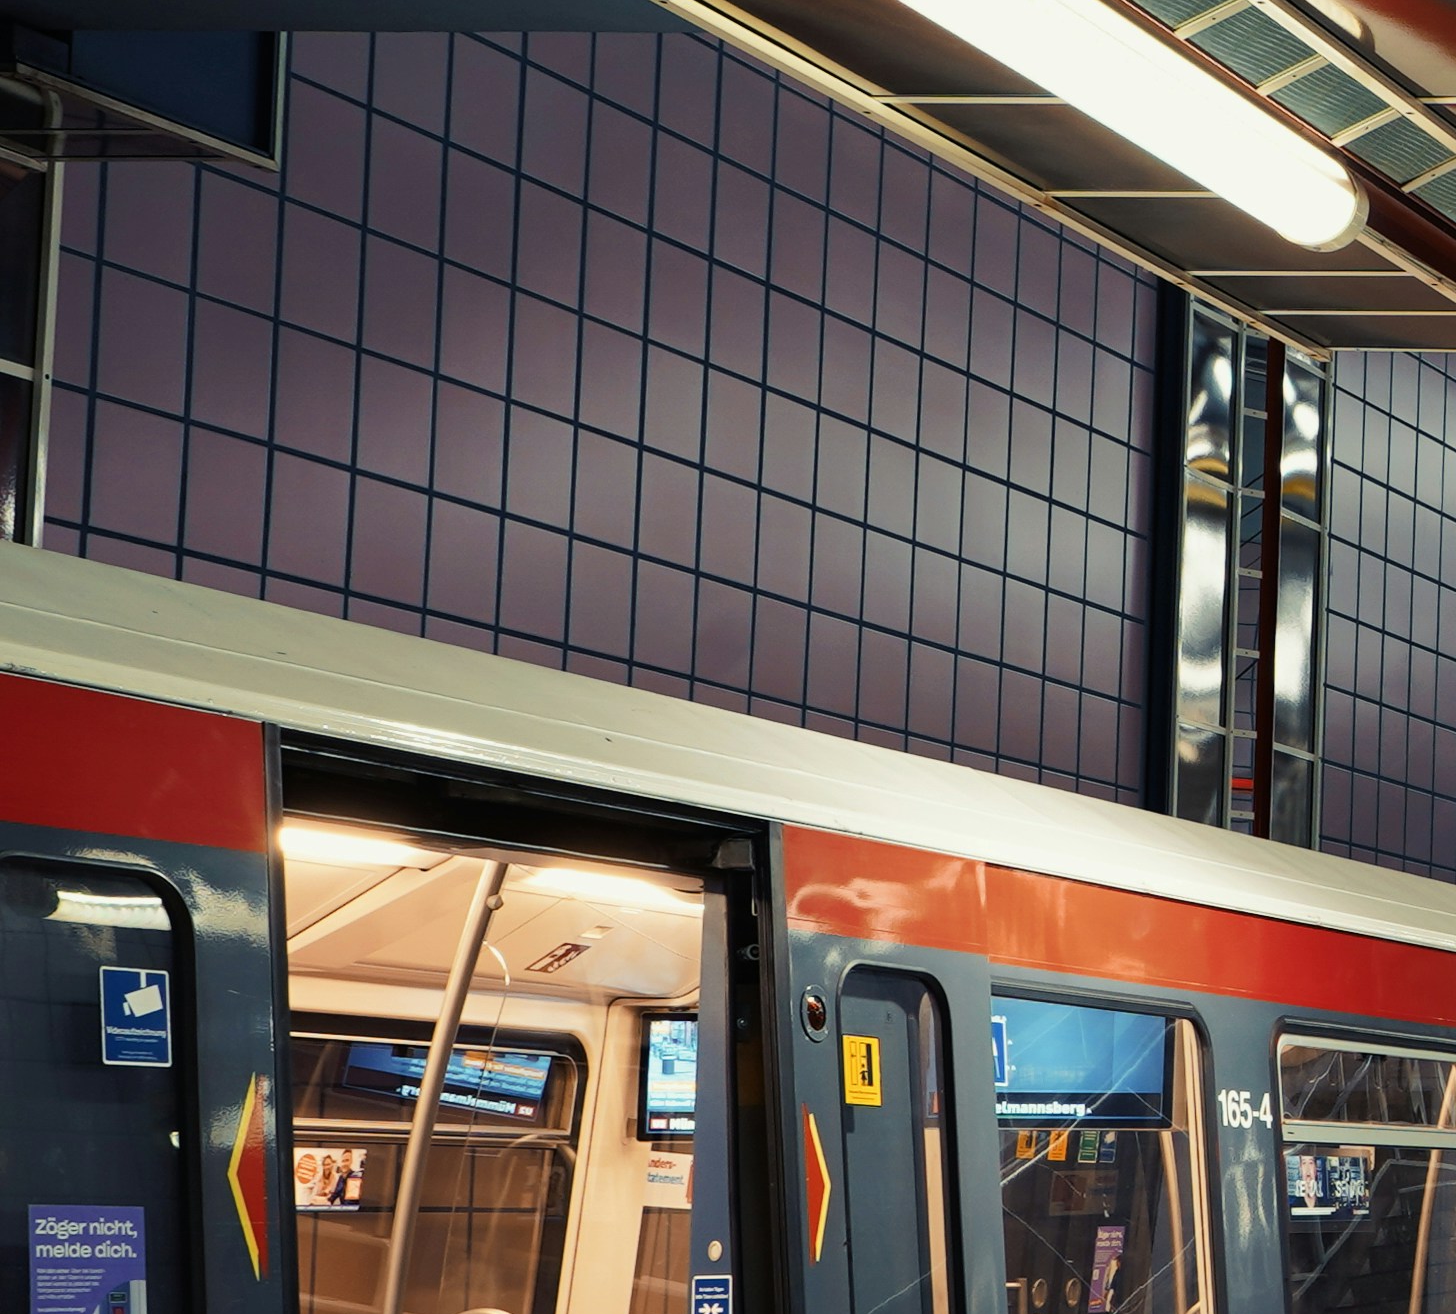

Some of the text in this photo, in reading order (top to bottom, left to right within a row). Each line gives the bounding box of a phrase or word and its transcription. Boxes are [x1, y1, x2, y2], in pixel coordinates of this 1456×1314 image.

[1217, 1089, 1273, 1129] 165-4
[34, 1216, 139, 1240] Zöger nicht,
[35, 1239, 138, 1258] melde dich.
